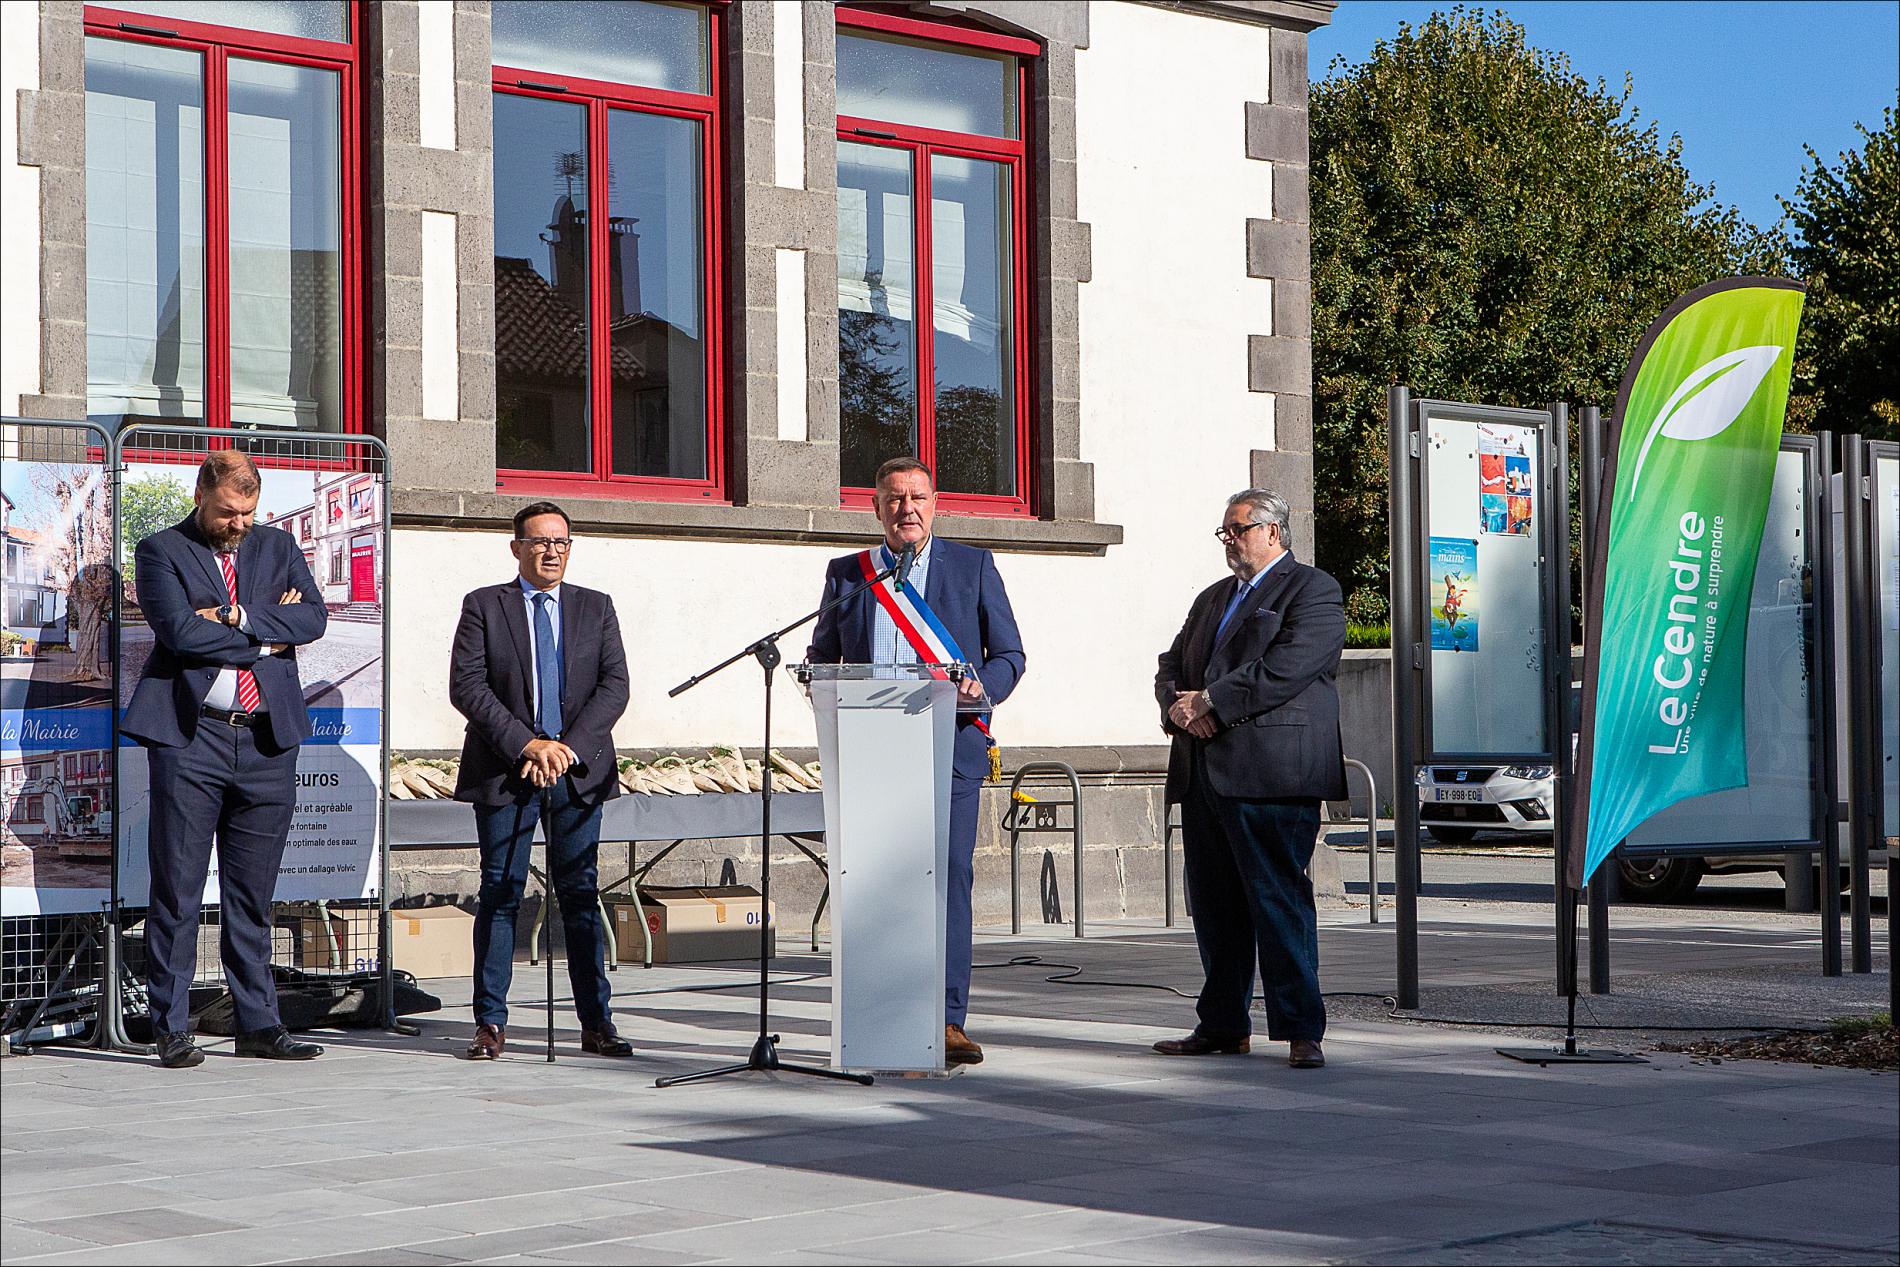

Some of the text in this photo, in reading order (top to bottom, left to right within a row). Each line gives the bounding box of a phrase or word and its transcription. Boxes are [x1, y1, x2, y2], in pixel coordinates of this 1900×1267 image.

[1708, 515, 1725, 596] surprendre
[1653, 511, 1706, 689] Cendre
[1704, 601, 1719, 610] à
[1703, 614, 1718, 663] nature
[1698, 667, 1709, 687] de
[1, 718, 81, 742] la Mairie
[1679, 725, 1692, 754] Une
[304, 803, 314, 813] et
[315, 802, 353, 815] agréable
[296, 821, 328, 831] fontaine
[292, 838, 326, 848] optimale
[327, 838, 340, 847] des
[341, 838, 358, 846] eaux
[297, 866, 307, 874] un
[308, 864, 336, 875] dallage
[337, 862, 356, 873] Volvic
